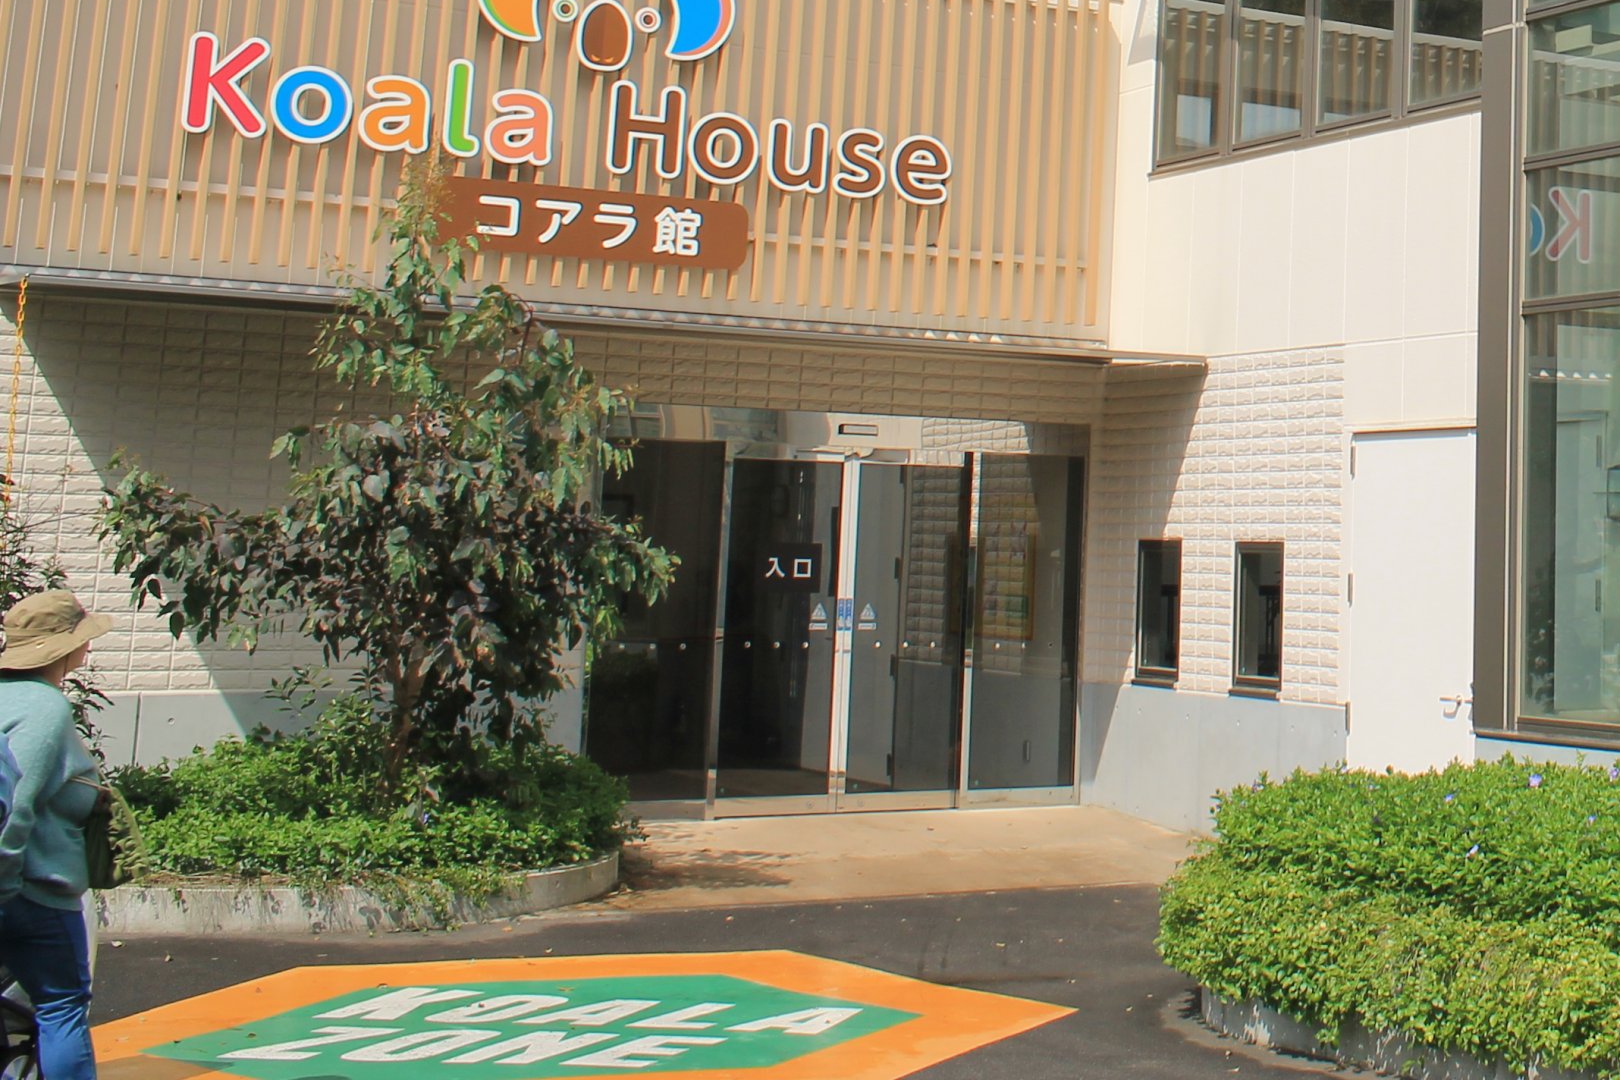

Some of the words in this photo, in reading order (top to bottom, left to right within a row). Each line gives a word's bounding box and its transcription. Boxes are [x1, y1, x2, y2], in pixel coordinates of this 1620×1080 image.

[182, 31, 553, 165] Koala
[606, 79, 952, 206] House
[476, 195, 702, 256] コアラ館
[765, 557, 812, 578] 入口
[312, 987, 864, 1034] KOALA
[216, 1026, 729, 1068] ZONE
